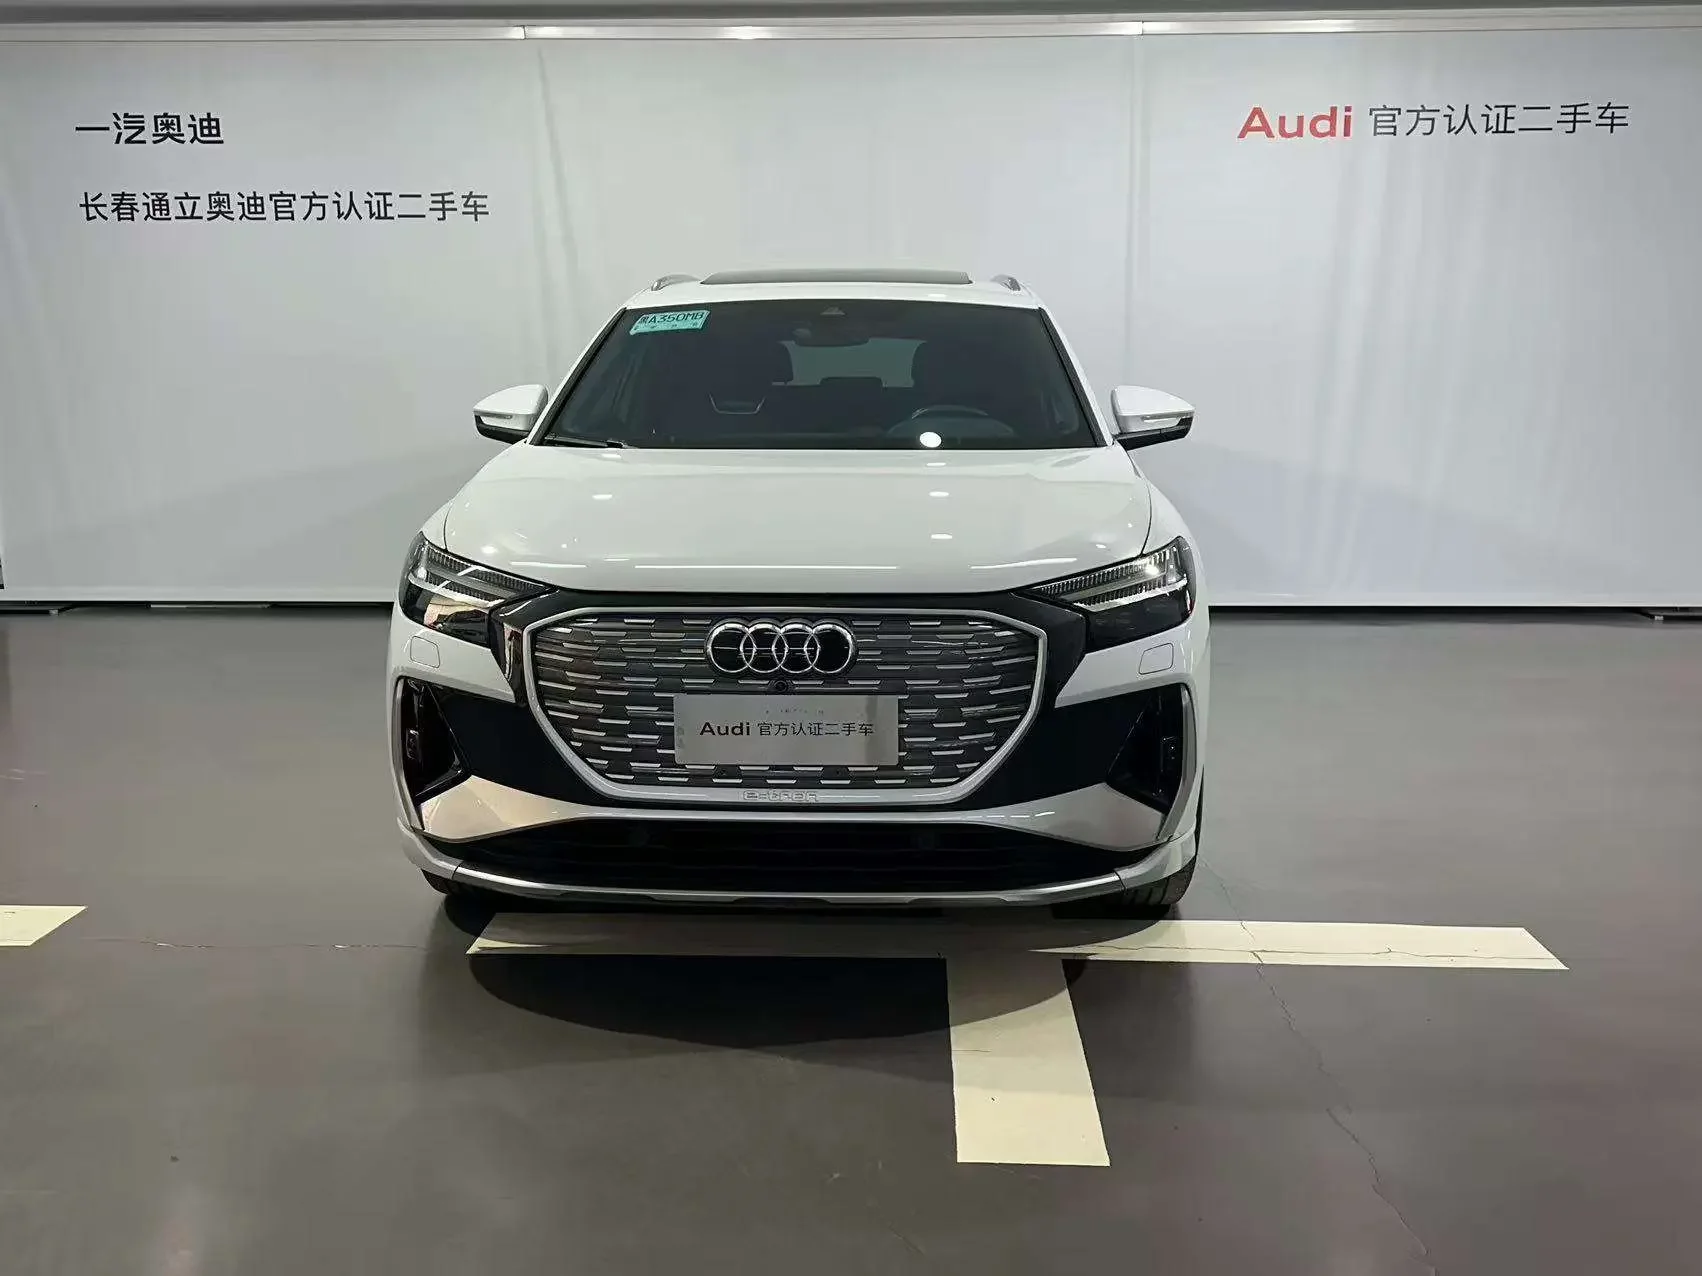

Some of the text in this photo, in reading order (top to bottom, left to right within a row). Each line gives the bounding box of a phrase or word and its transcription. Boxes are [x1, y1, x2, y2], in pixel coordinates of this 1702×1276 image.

[75, 112, 224, 144] 一汽奥迪
[1237, 102, 1629, 138] Audi 官方认证二手车
[79, 191, 489, 224] 长春通立奥迪官方认证二手车
[700, 720, 876, 736] Audi 官方认证二手车
[743, 789, 818, 803] e-tron
